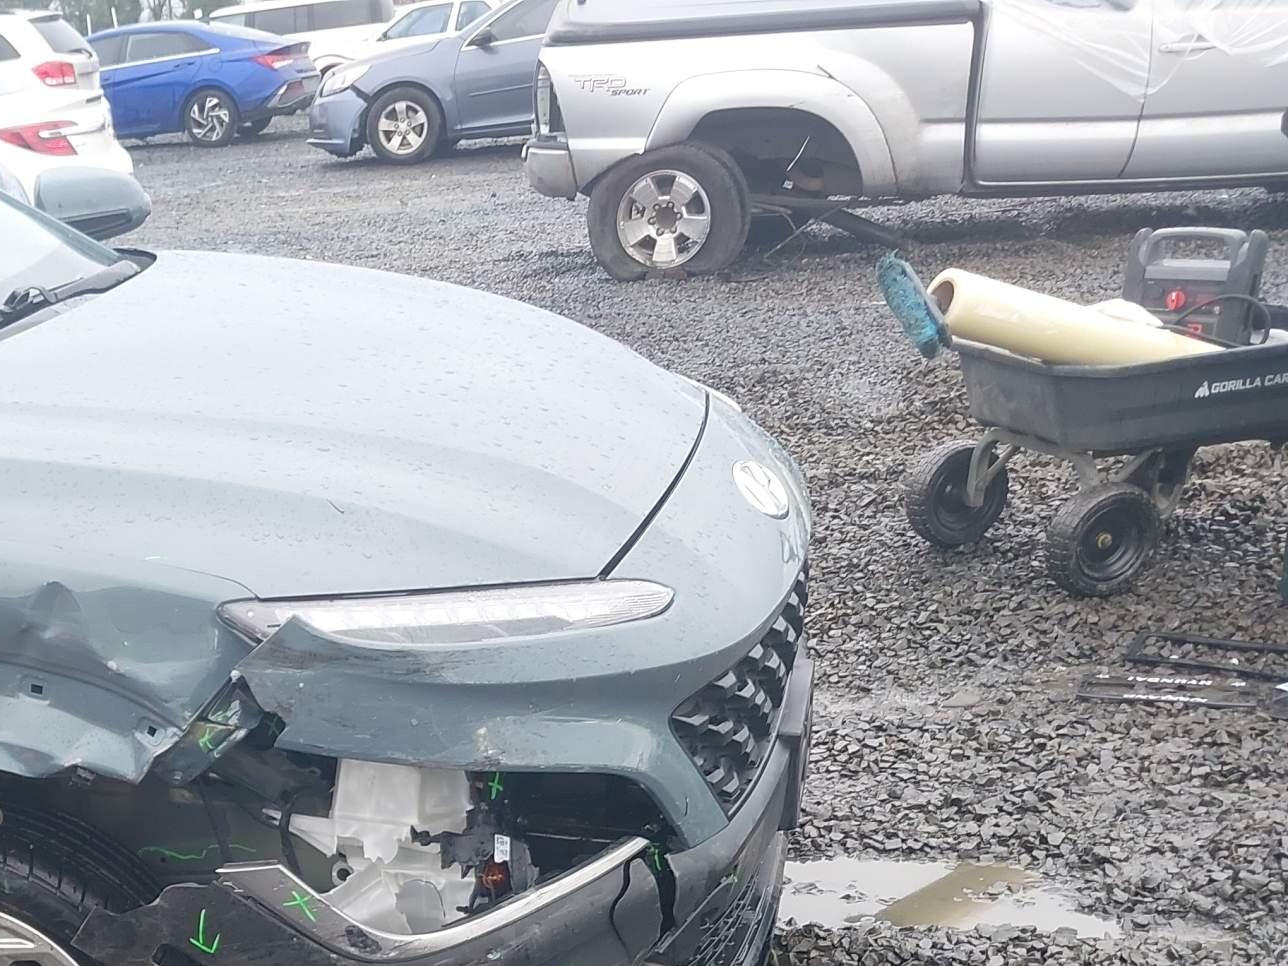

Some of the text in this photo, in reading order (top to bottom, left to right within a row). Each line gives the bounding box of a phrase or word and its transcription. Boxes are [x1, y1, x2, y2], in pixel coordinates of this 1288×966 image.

[575, 78, 627, 92] TRD
[610, 88, 650, 96] SPORT
[1211, 377, 1262, 393] GORILLA
